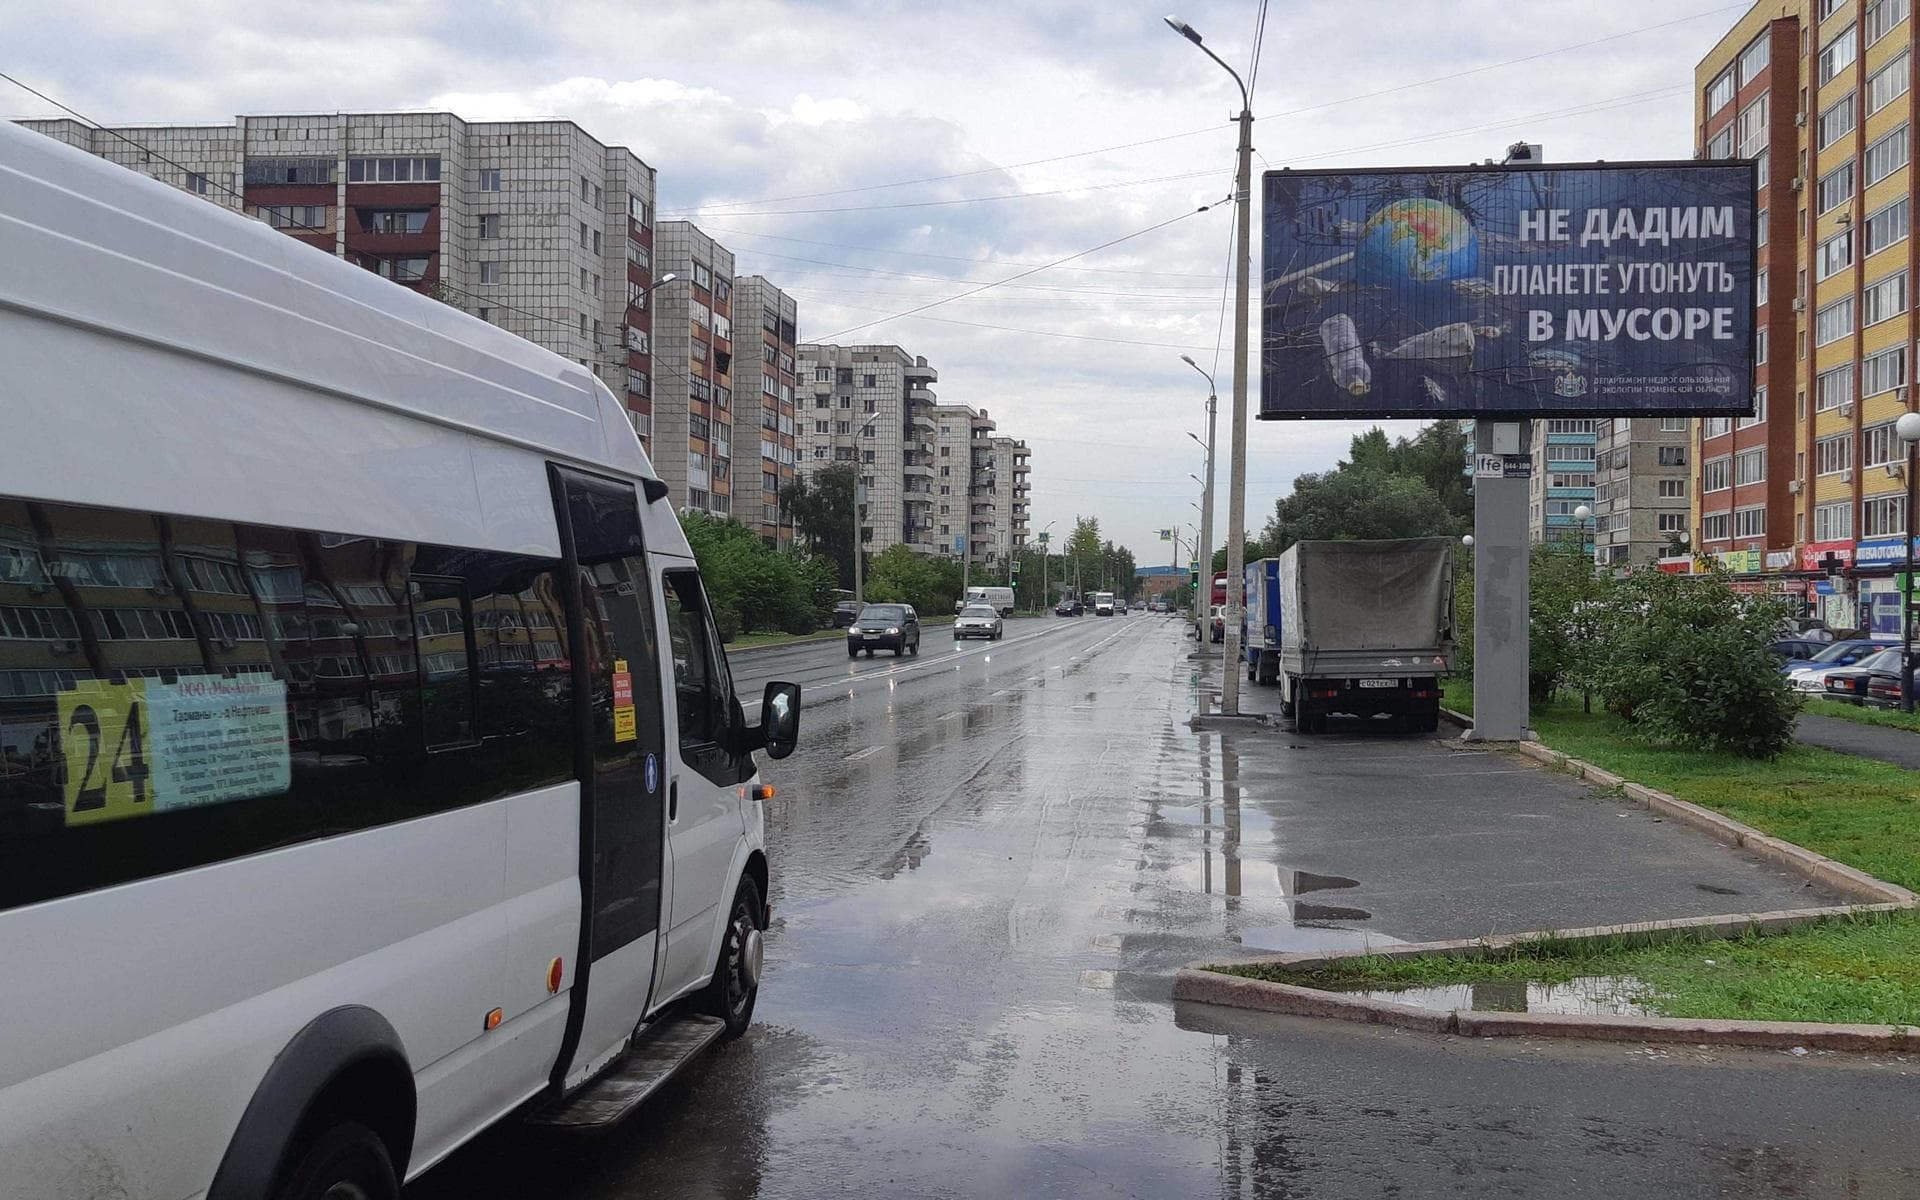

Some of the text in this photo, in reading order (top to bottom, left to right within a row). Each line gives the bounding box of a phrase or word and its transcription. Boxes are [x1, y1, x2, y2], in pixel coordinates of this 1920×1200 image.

[1519, 206, 1736, 248] НЕ ДАДИМ
[1493, 261, 1735, 296] ПЛАНЕТЕ УТОНУТЬ
[1528, 307, 1735, 342] В МУСОРЕ
[1593, 377, 1647, 385] ДЕПАРТАМЕНТ
[68, 701, 150, 813] 24
